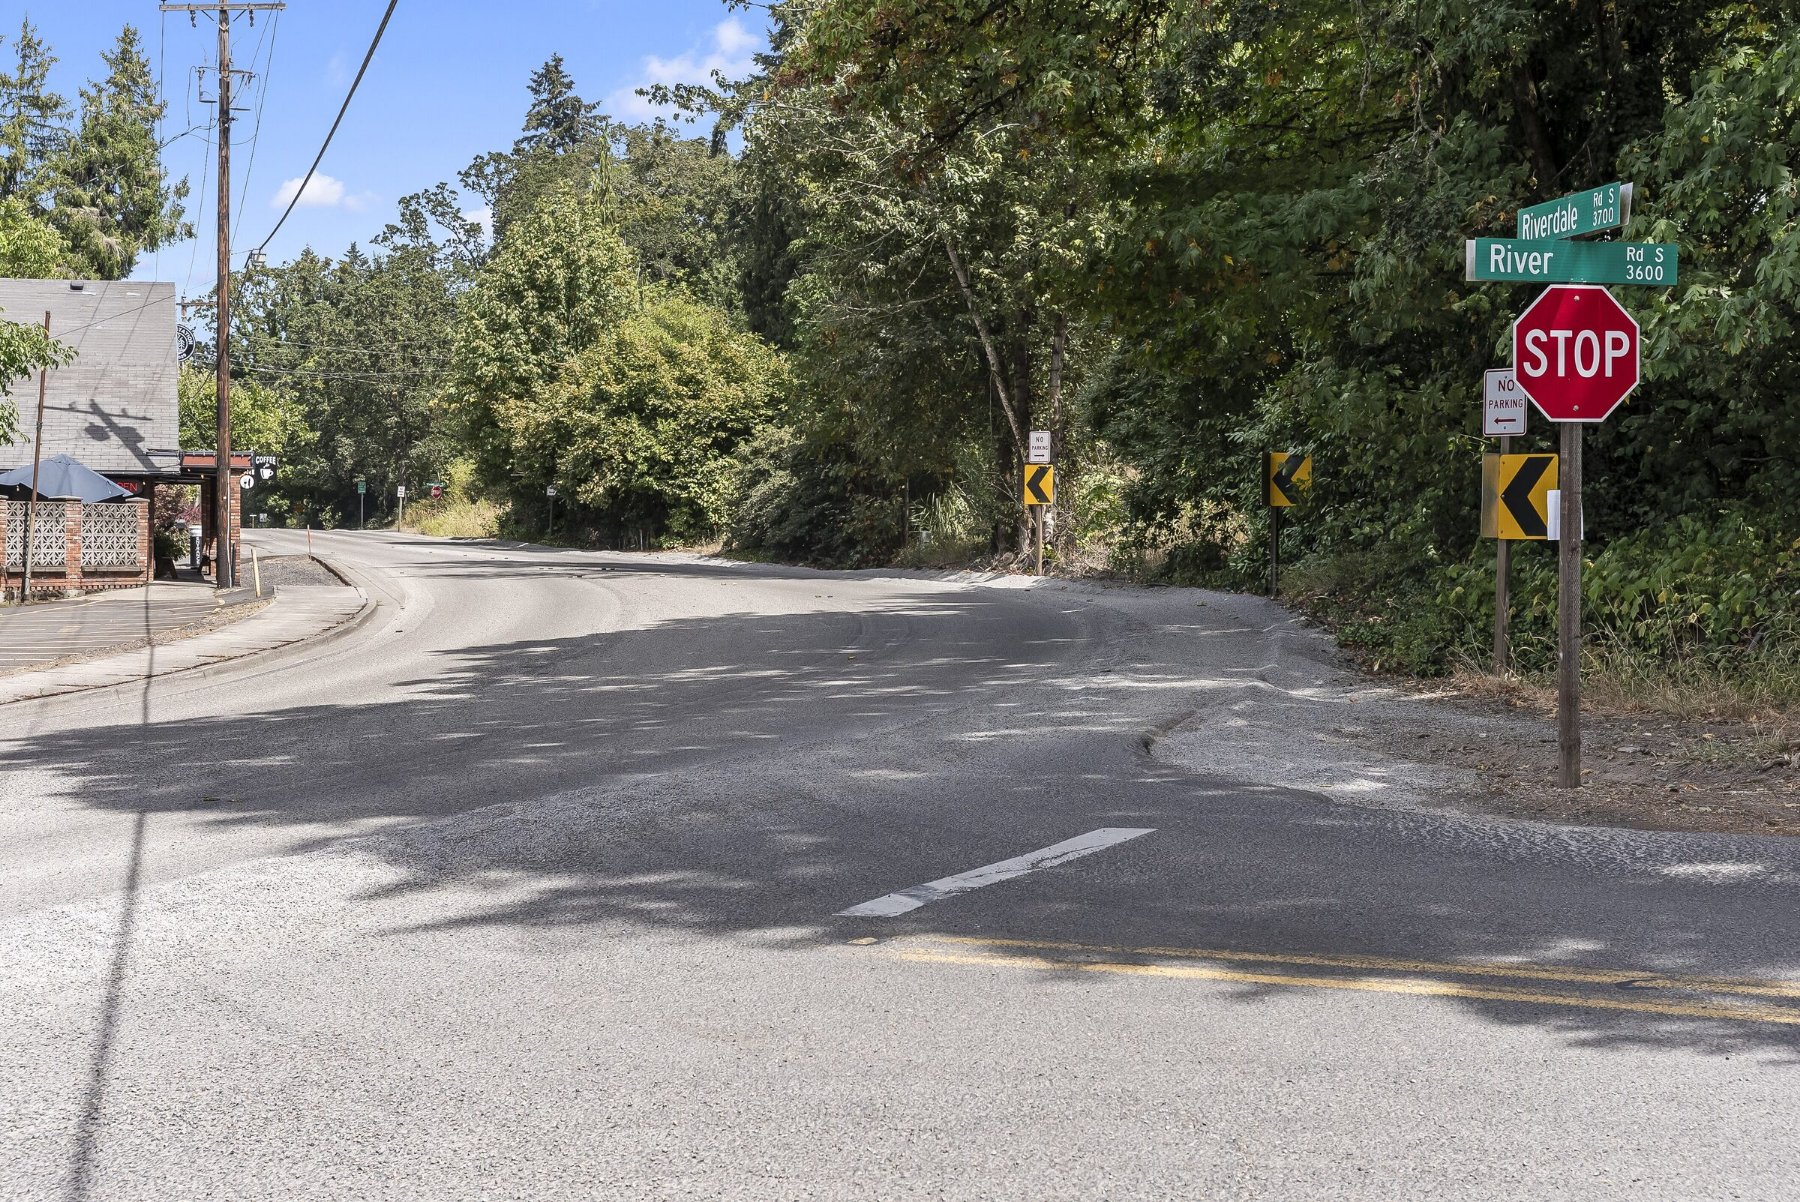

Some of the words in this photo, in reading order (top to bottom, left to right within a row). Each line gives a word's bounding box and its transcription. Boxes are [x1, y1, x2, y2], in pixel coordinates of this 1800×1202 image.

[1593, 192, 1603, 208] Rd
[1608, 187, 1615, 204] S
[1522, 203, 1578, 240] Riverdale
[1592, 207, 1614, 227] 3700
[1490, 244, 1553, 275] River
[1626, 246, 1644, 262] Rd
[1655, 247, 1664, 263] S
[1626, 265, 1664, 281] 3600
[178, 326, 193, 344] TATION
[1523, 328, 1630, 378] STOP
[1498, 379, 1515, 392] NO
[1488, 399, 1523, 410] PARKING
[255, 455, 276, 465] COFFEE
